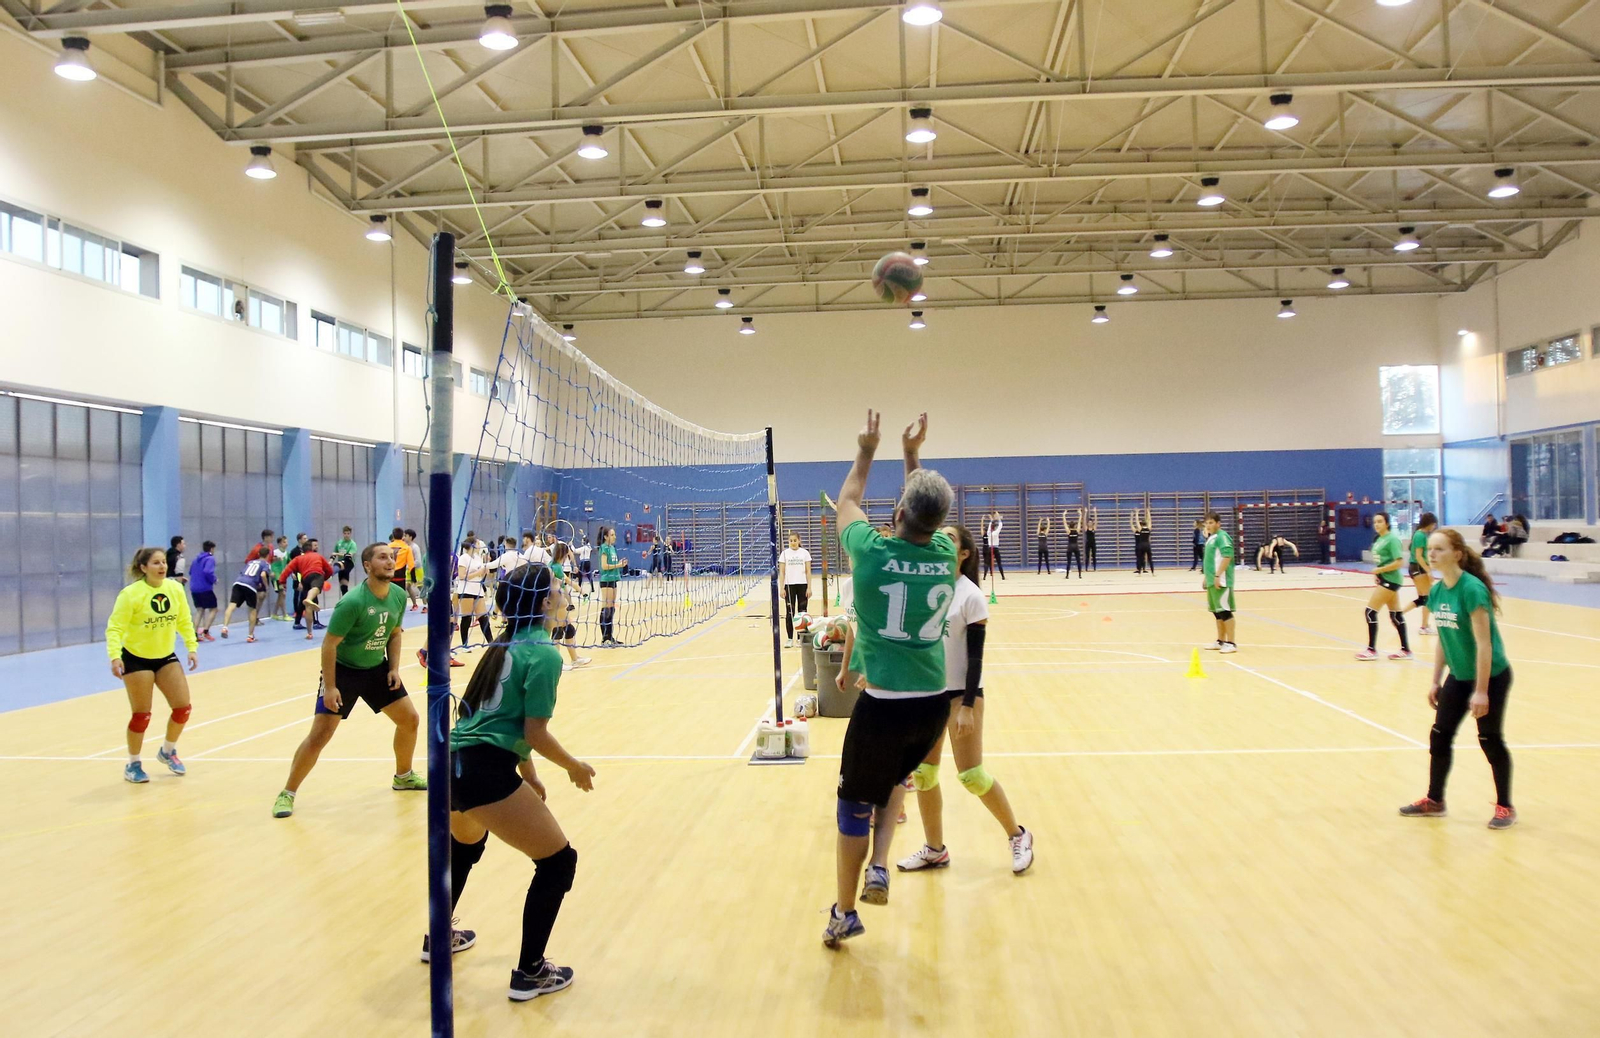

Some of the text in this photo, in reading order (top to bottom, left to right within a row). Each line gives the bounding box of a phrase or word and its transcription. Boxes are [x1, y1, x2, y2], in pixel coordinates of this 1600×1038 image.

[244, 563, 260, 577] 10
[881, 558, 951, 576] ALEX
[379, 611, 389, 625] 17
[877, 581, 954, 641] 12
